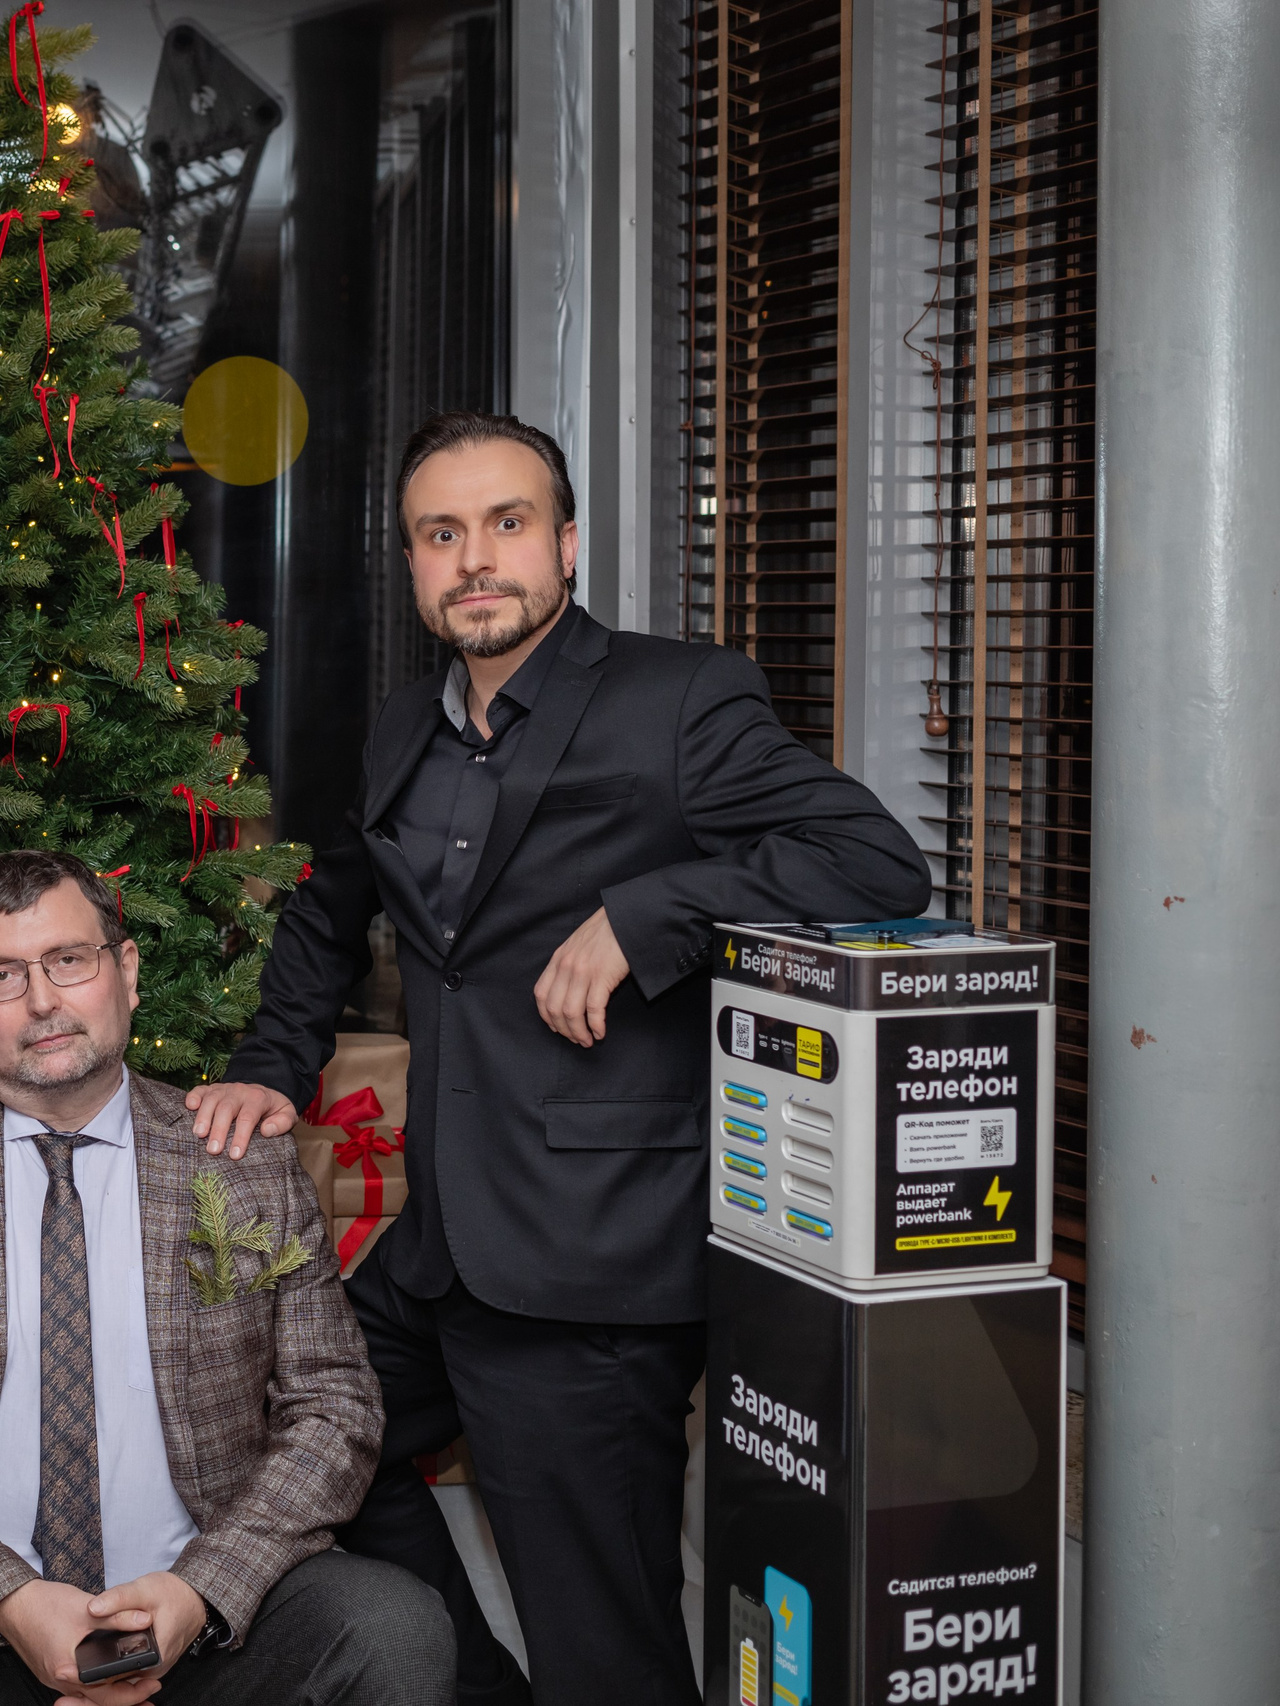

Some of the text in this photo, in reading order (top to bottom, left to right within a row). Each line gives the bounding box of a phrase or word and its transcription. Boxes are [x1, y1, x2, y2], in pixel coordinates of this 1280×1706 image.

[741, 947, 836, 992] Бери заряд!
[786, 950, 818, 966] телефон?
[880, 965, 1039, 998] Бери заряд!
[798, 1040, 820, 1052] ТАРИФ
[906, 1045, 1009, 1072] Заряди
[896, 1073, 1018, 1102] телефон
[904, 1120, 934, 1128] QR-Код
[896, 1182, 956, 1196] Аппарат
[896, 1197, 948, 1211] выдает
[896, 1207, 972, 1228] powerbank
[730, 1373, 818, 1447] Заряди
[722, 1417, 827, 1496] телефон
[888, 1563, 1037, 1595] Садится телефон?
[904, 1606, 1021, 1653] Бери
[776, 1641, 795, 1660] Бери
[776, 1654, 798, 1676] заряд!
[887, 1645, 1037, 1706] заряд!
